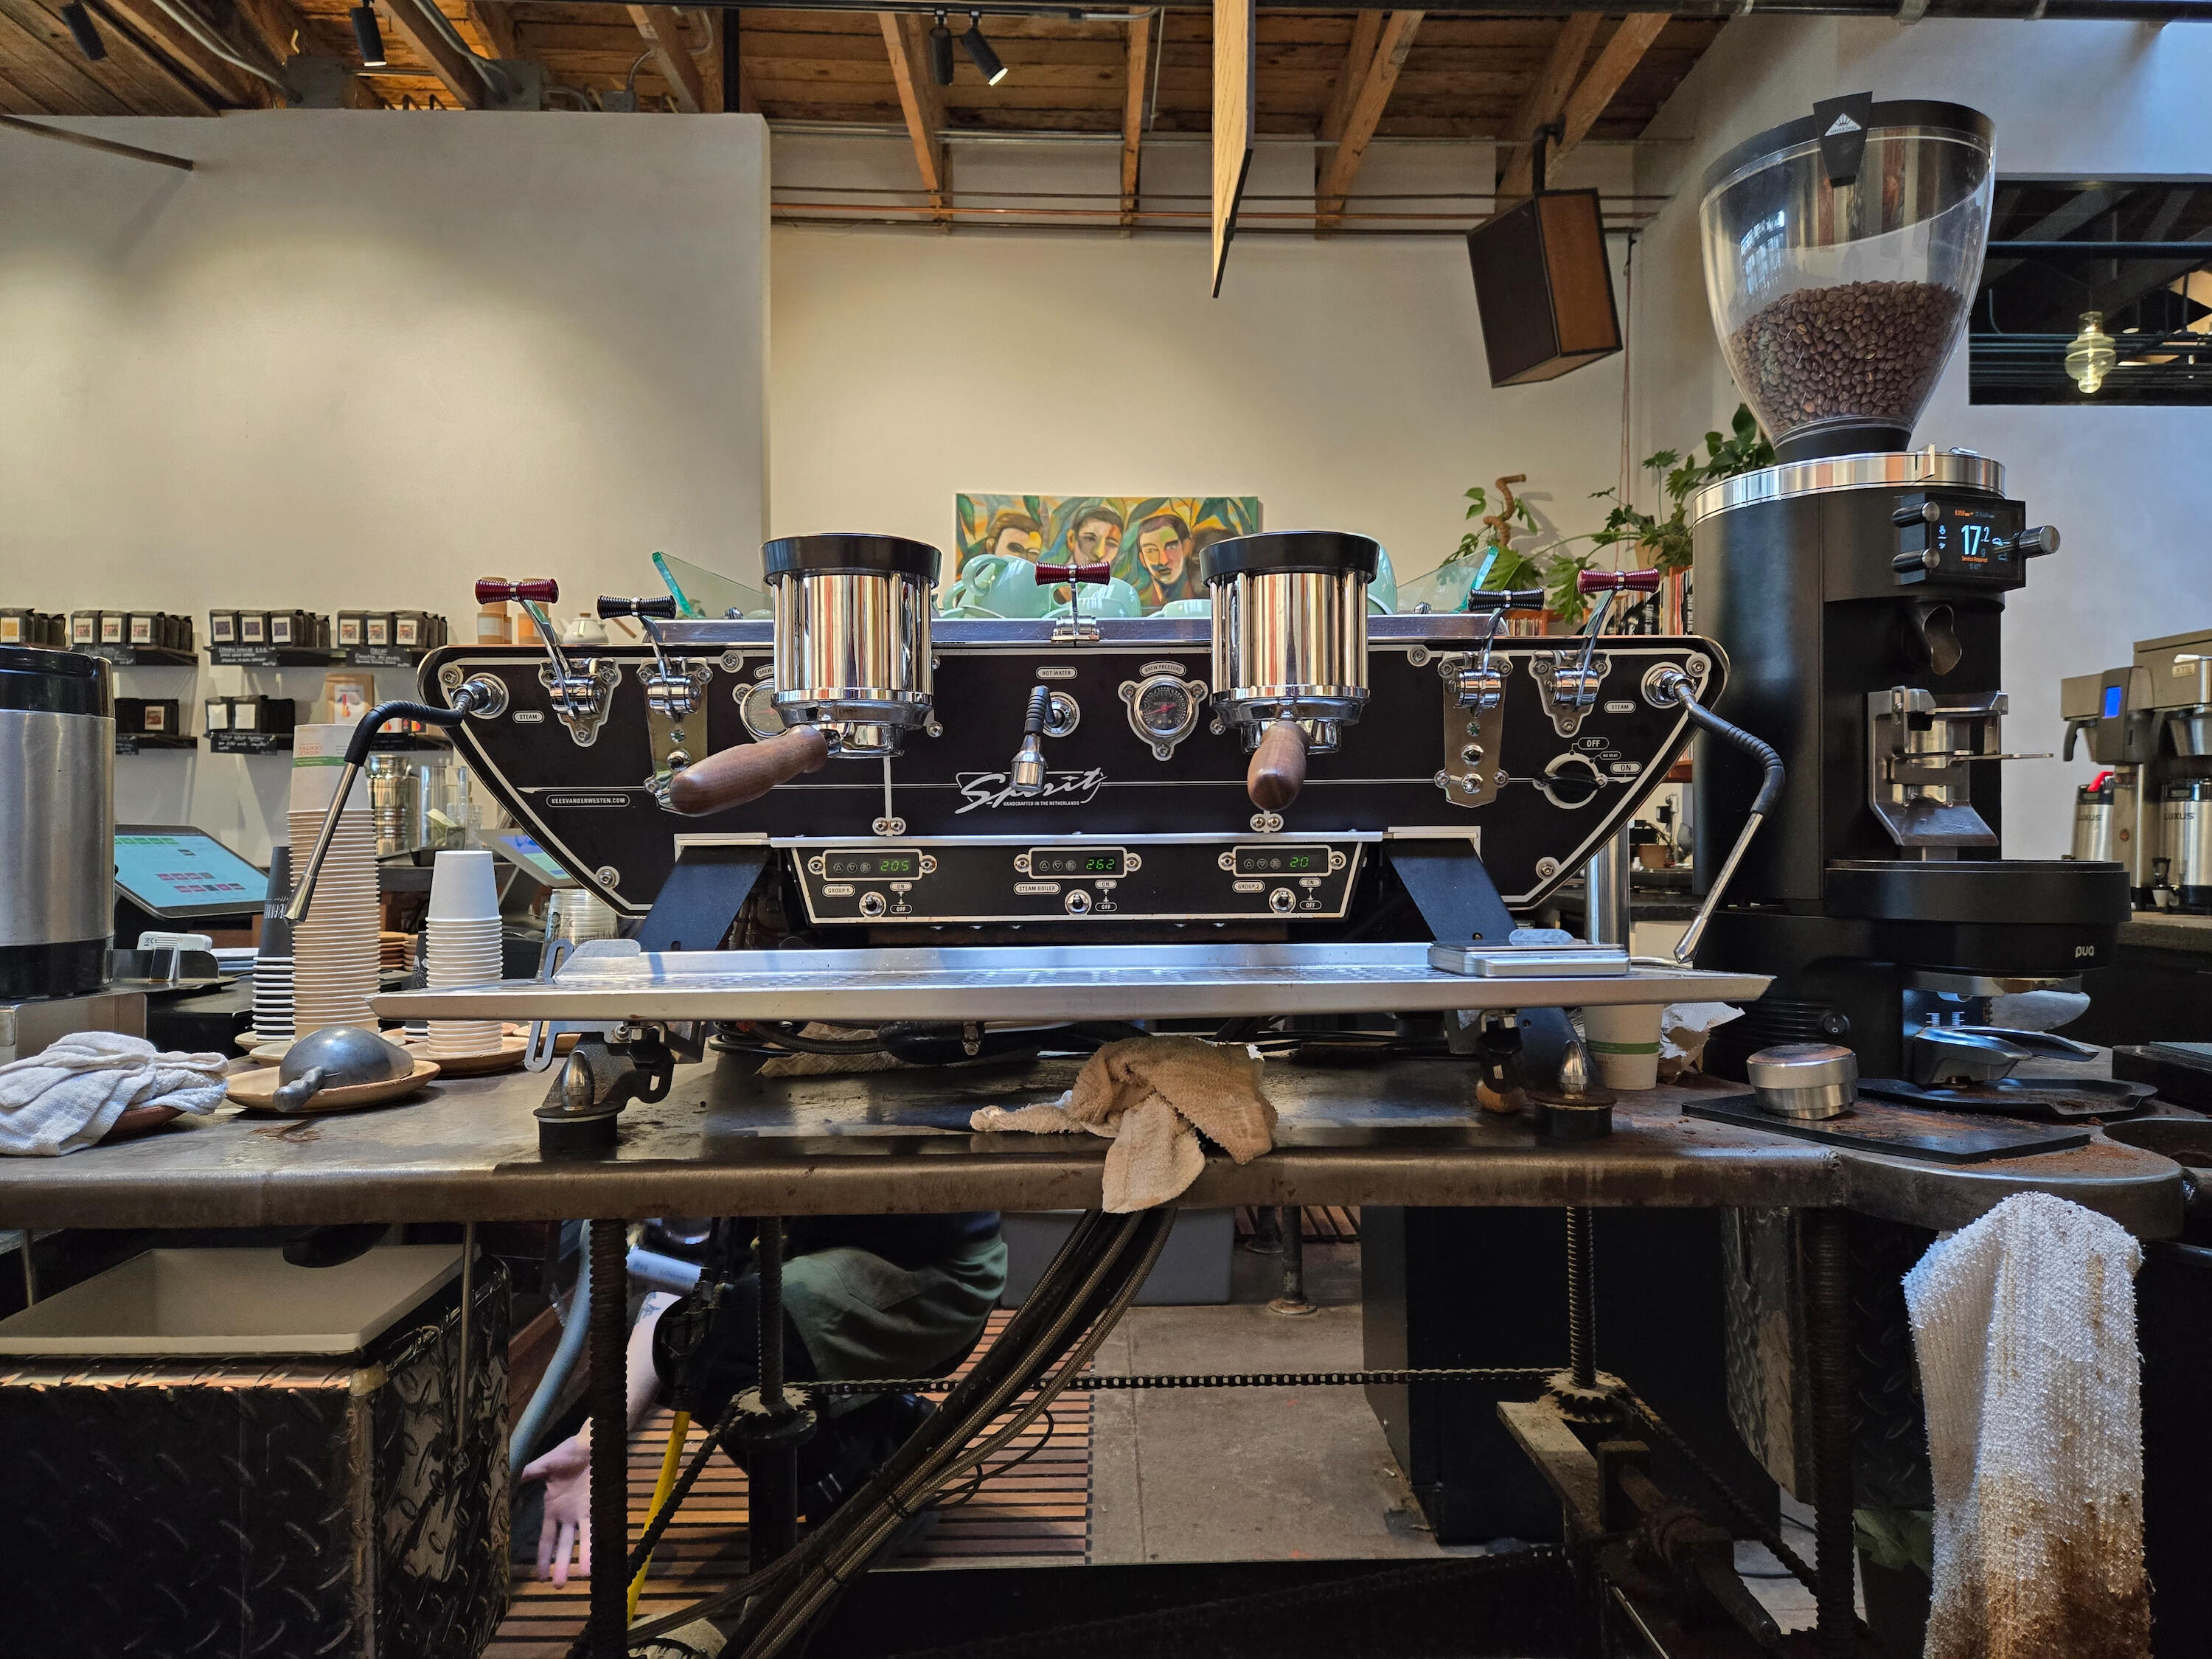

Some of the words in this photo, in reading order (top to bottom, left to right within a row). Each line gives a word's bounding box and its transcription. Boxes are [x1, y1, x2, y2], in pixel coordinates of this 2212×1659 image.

[1144, 664, 1158, 673] BREW
[1158, 664, 1182, 673] PRESSURE
[1586, 740, 1601, 748] OFF
[880, 860, 909, 872] 205
[1085, 858, 1115, 870] 262
[1290, 856, 1310, 868] 20
